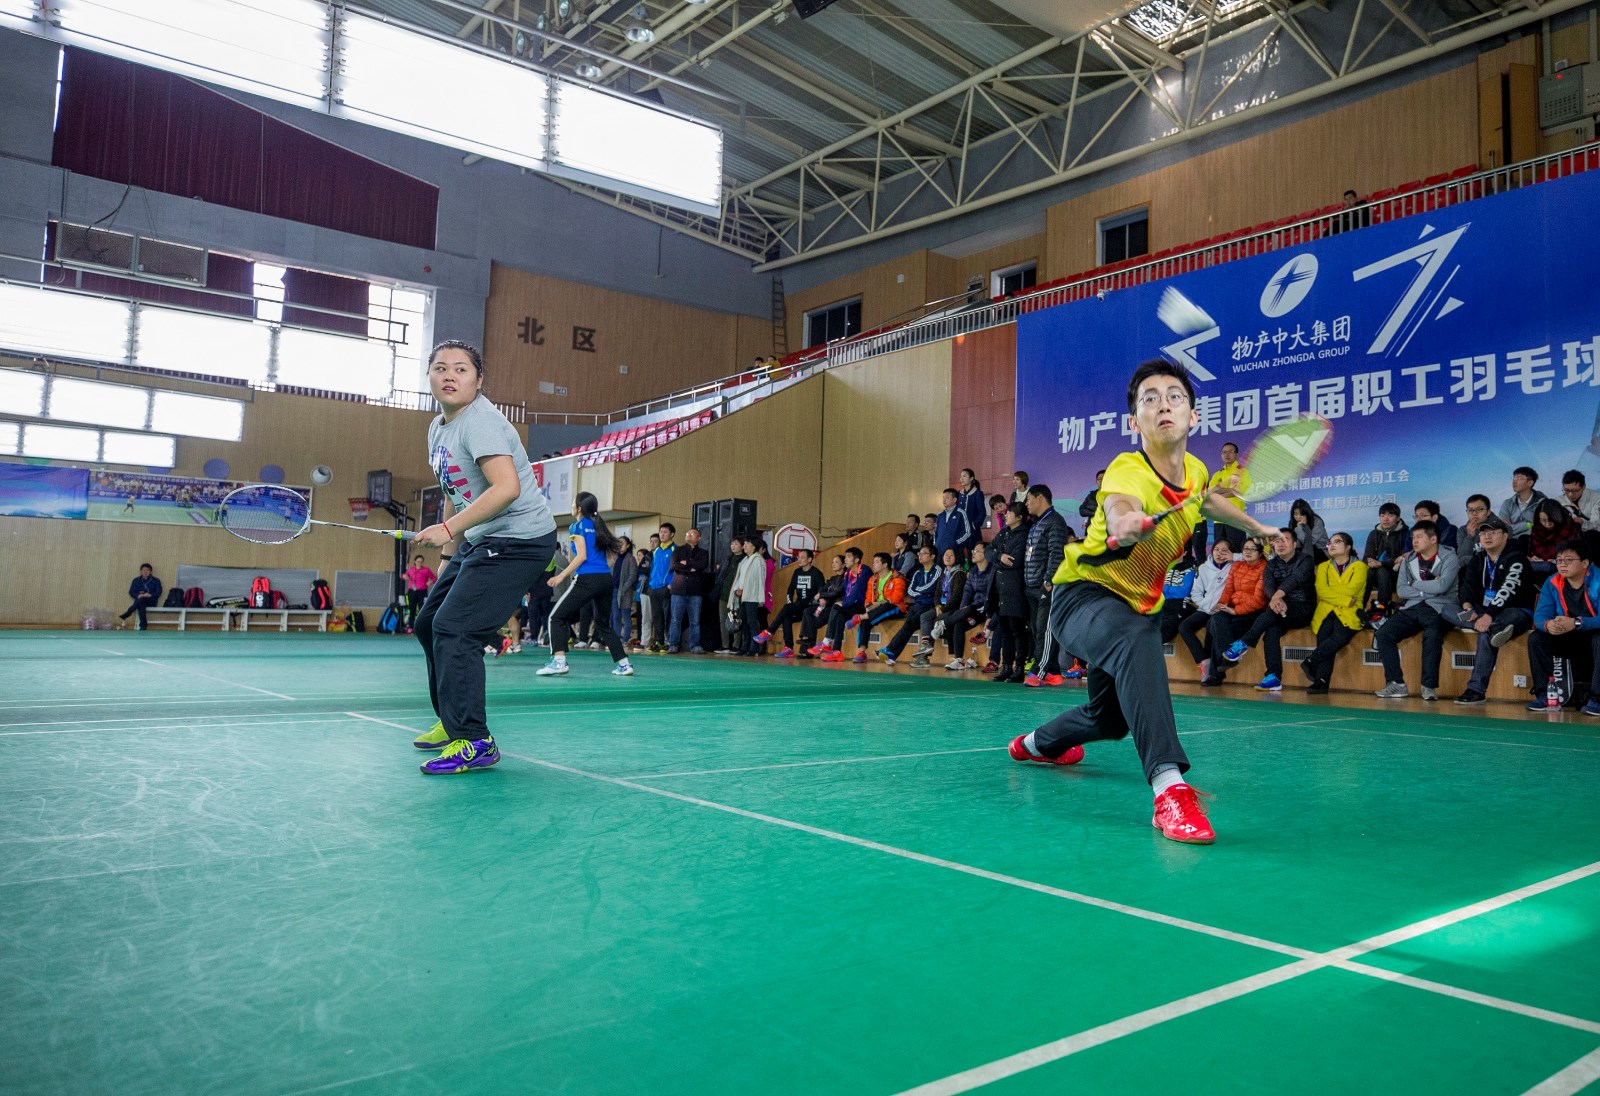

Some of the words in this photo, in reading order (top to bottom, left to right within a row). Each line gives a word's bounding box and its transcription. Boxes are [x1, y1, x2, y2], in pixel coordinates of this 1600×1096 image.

[517, 316, 597, 353] 北区
[1231, 315, 1351, 361] 物产中大集团
[1232, 360, 1270, 374] WUCHAN
[1272, 352, 1316, 367] ZHONGDA
[1317, 345, 1351, 359] GROUP
[1058, 335, 1600, 454] 物产集团首届职工羽毛球
[1491, 562, 1524, 608] adidas
[1552, 655, 1564, 682] YONE
